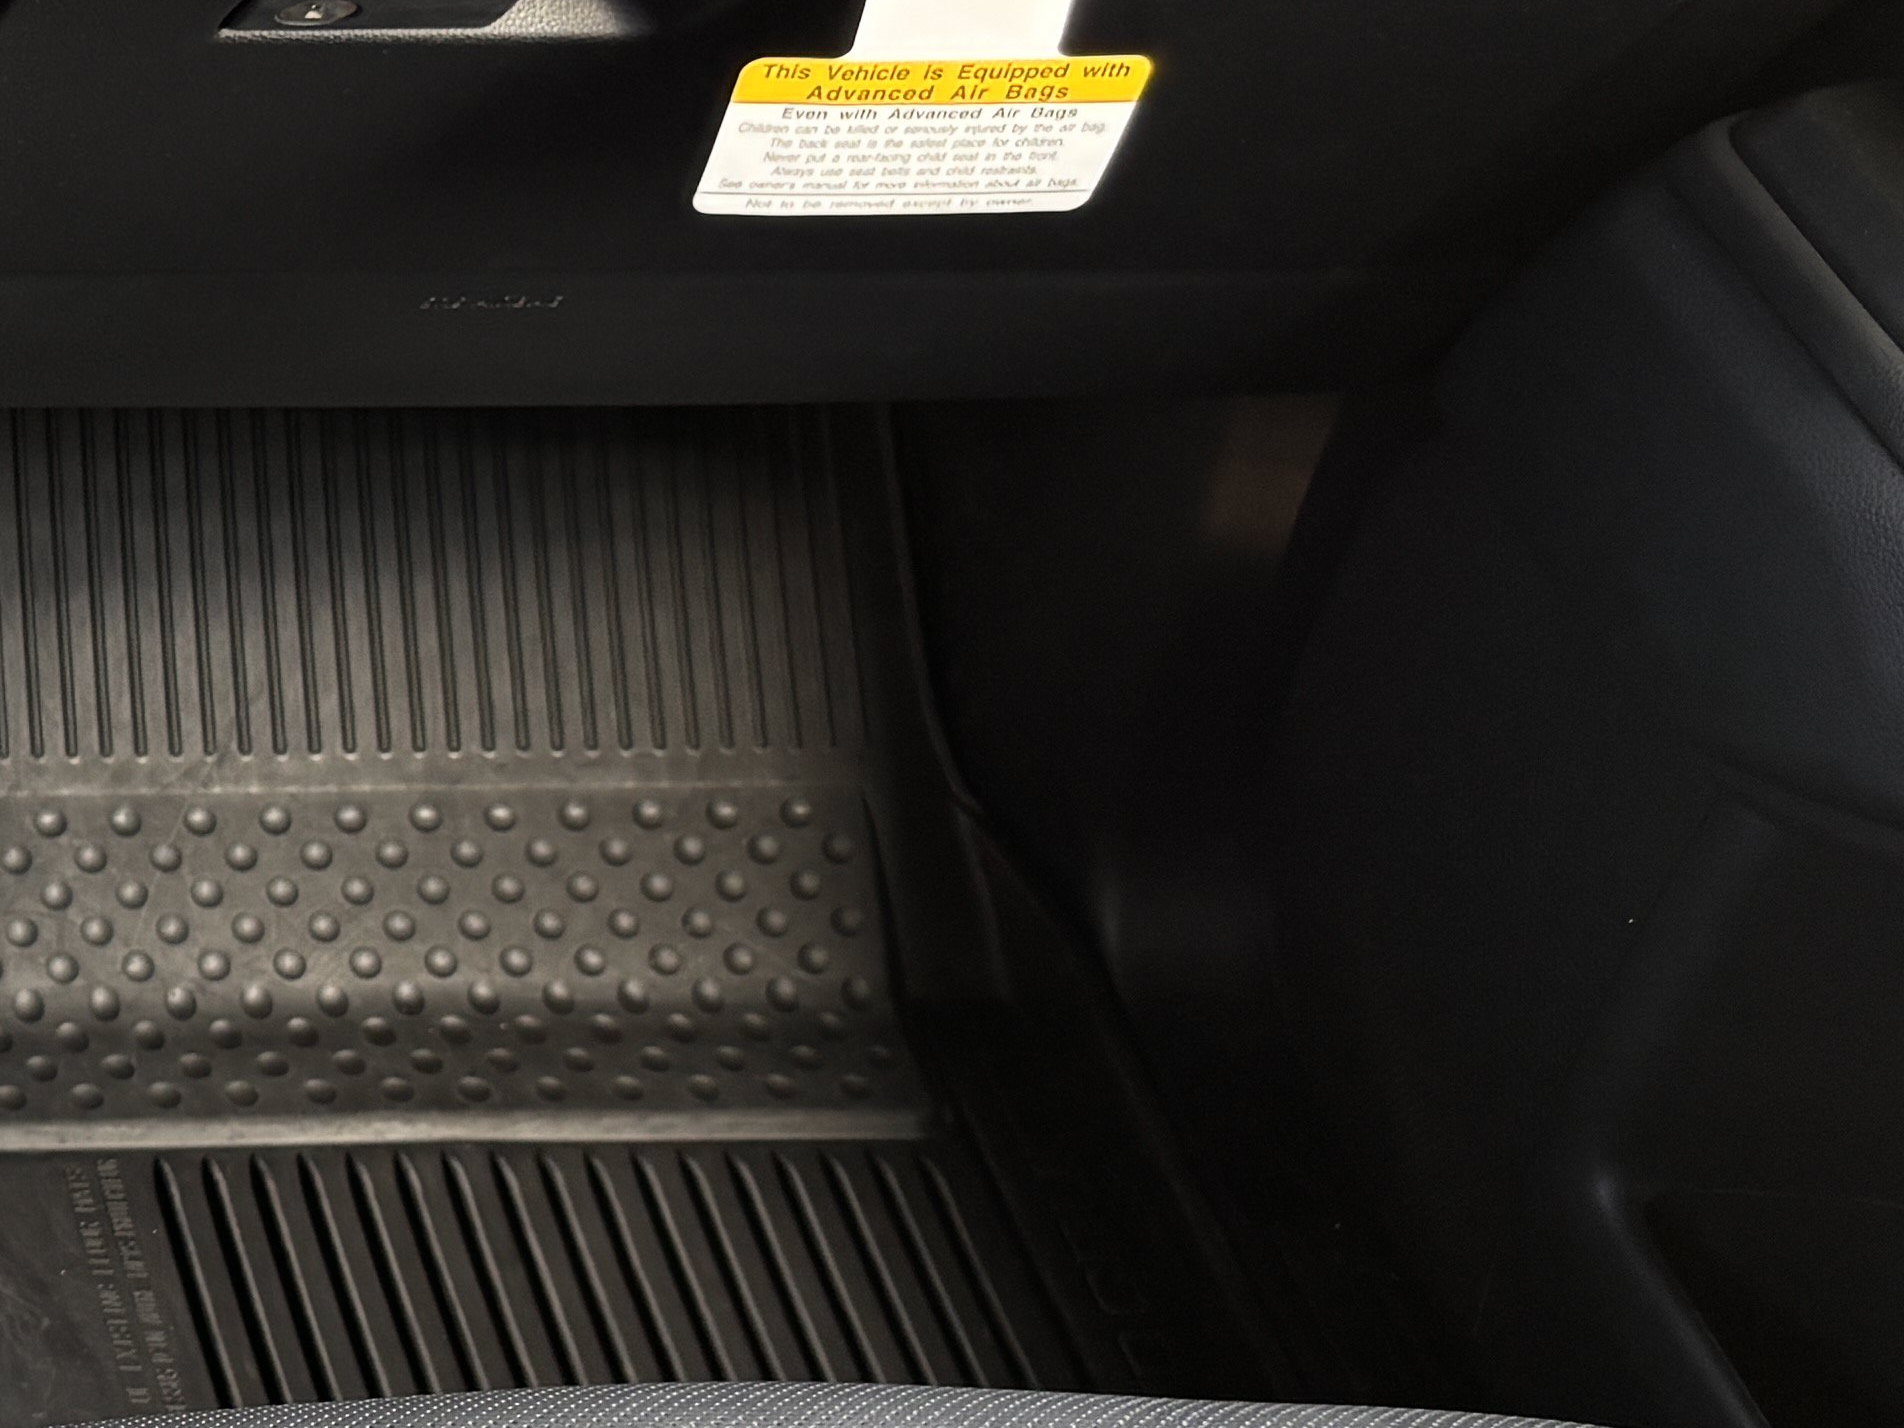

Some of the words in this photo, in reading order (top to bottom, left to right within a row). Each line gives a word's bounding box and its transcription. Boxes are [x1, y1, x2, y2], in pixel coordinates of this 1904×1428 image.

[764, 63, 811, 80] This
[828, 63, 910, 81] Vehicle
[924, 63, 943, 80] is
[958, 63, 1070, 83] Equipped
[1083, 62, 1130, 78] with
[806, 85, 934, 101] Advanced
[950, 84, 989, 100] Air
[1005, 84, 1068, 102] Bags
[782, 107, 827, 120] Even
[840, 107, 877, 120] with
[888, 107, 982, 120] Advanced
[992, 107, 1020, 119] Air
[1030, 107, 1078, 121] Bags
